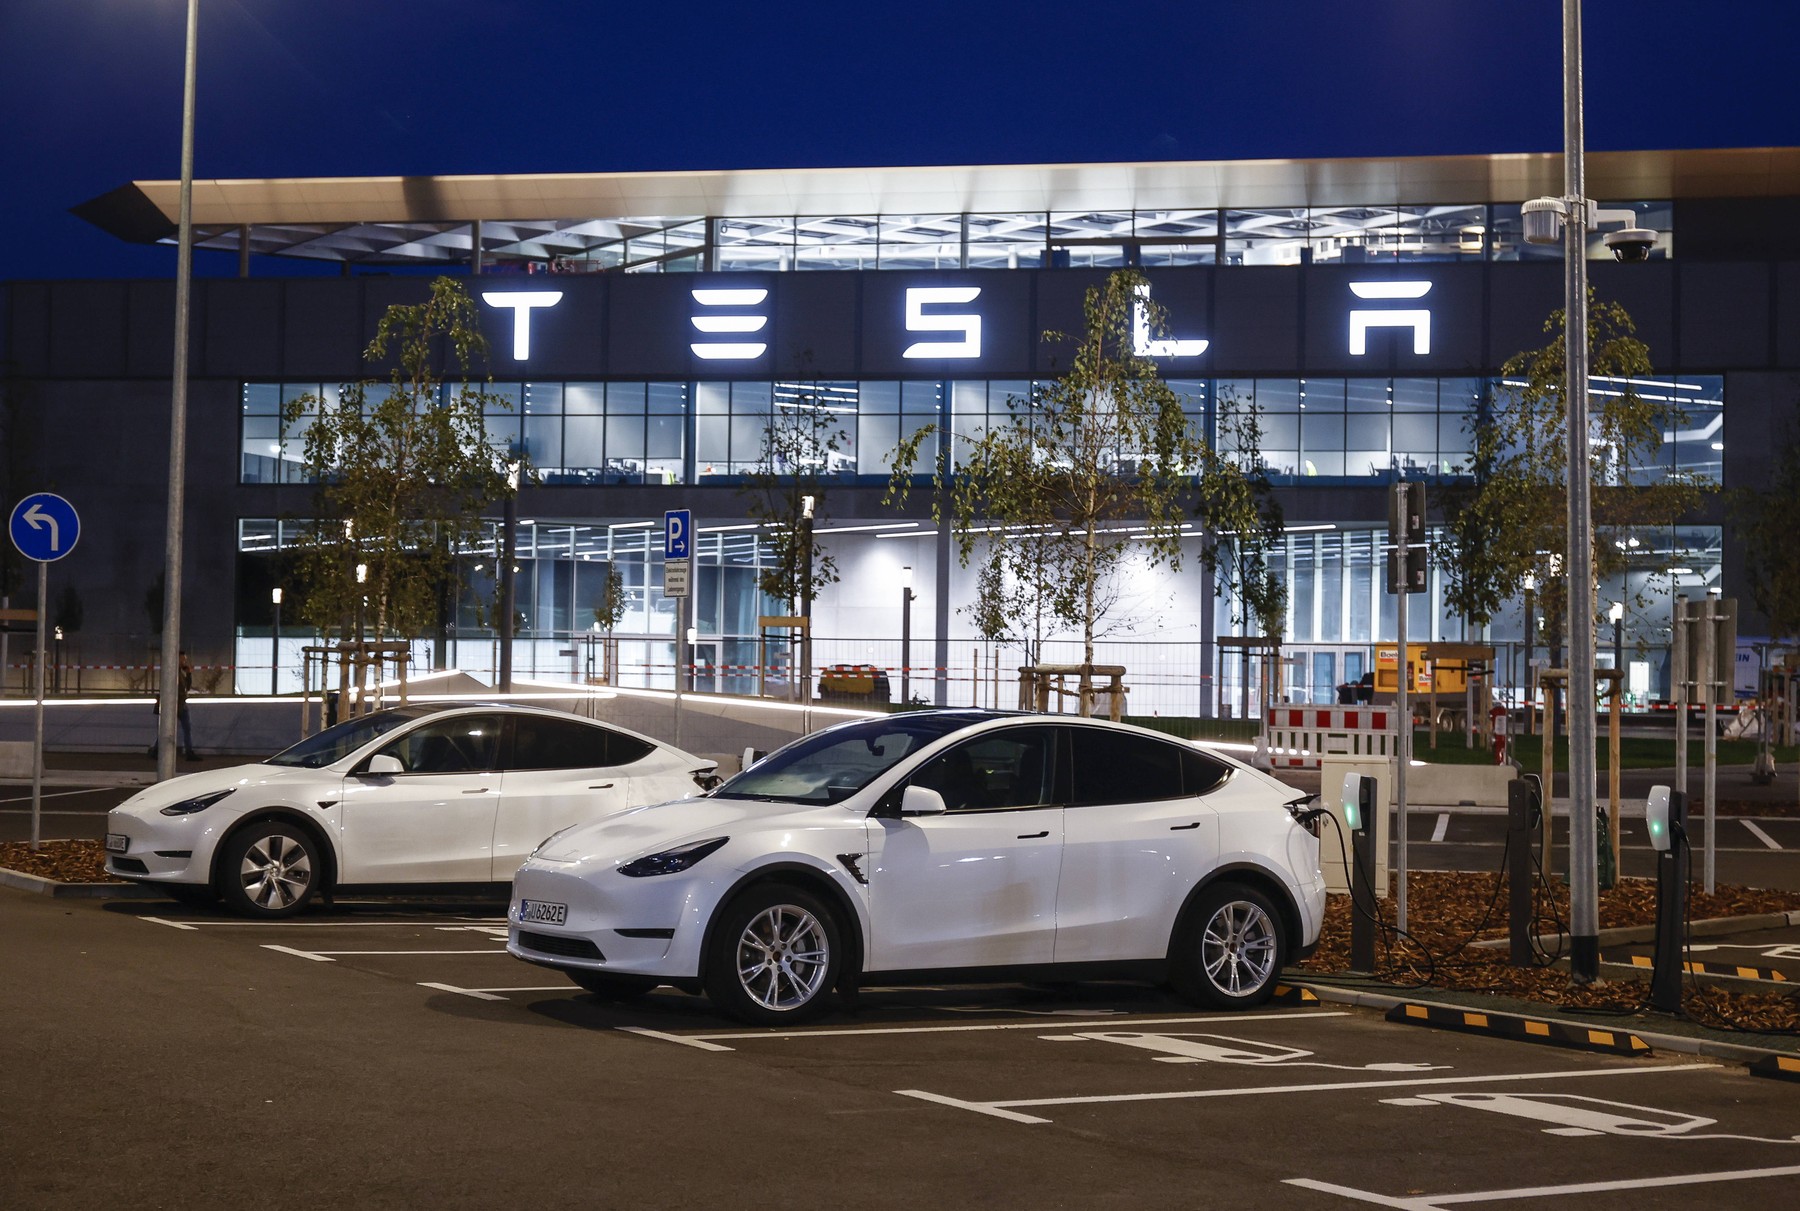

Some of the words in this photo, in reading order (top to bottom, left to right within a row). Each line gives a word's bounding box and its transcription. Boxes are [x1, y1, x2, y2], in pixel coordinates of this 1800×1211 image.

[482, 281, 1433, 360] TESLA
[669, 517, 682, 553] P
[1736, 654, 1750, 662] IN
